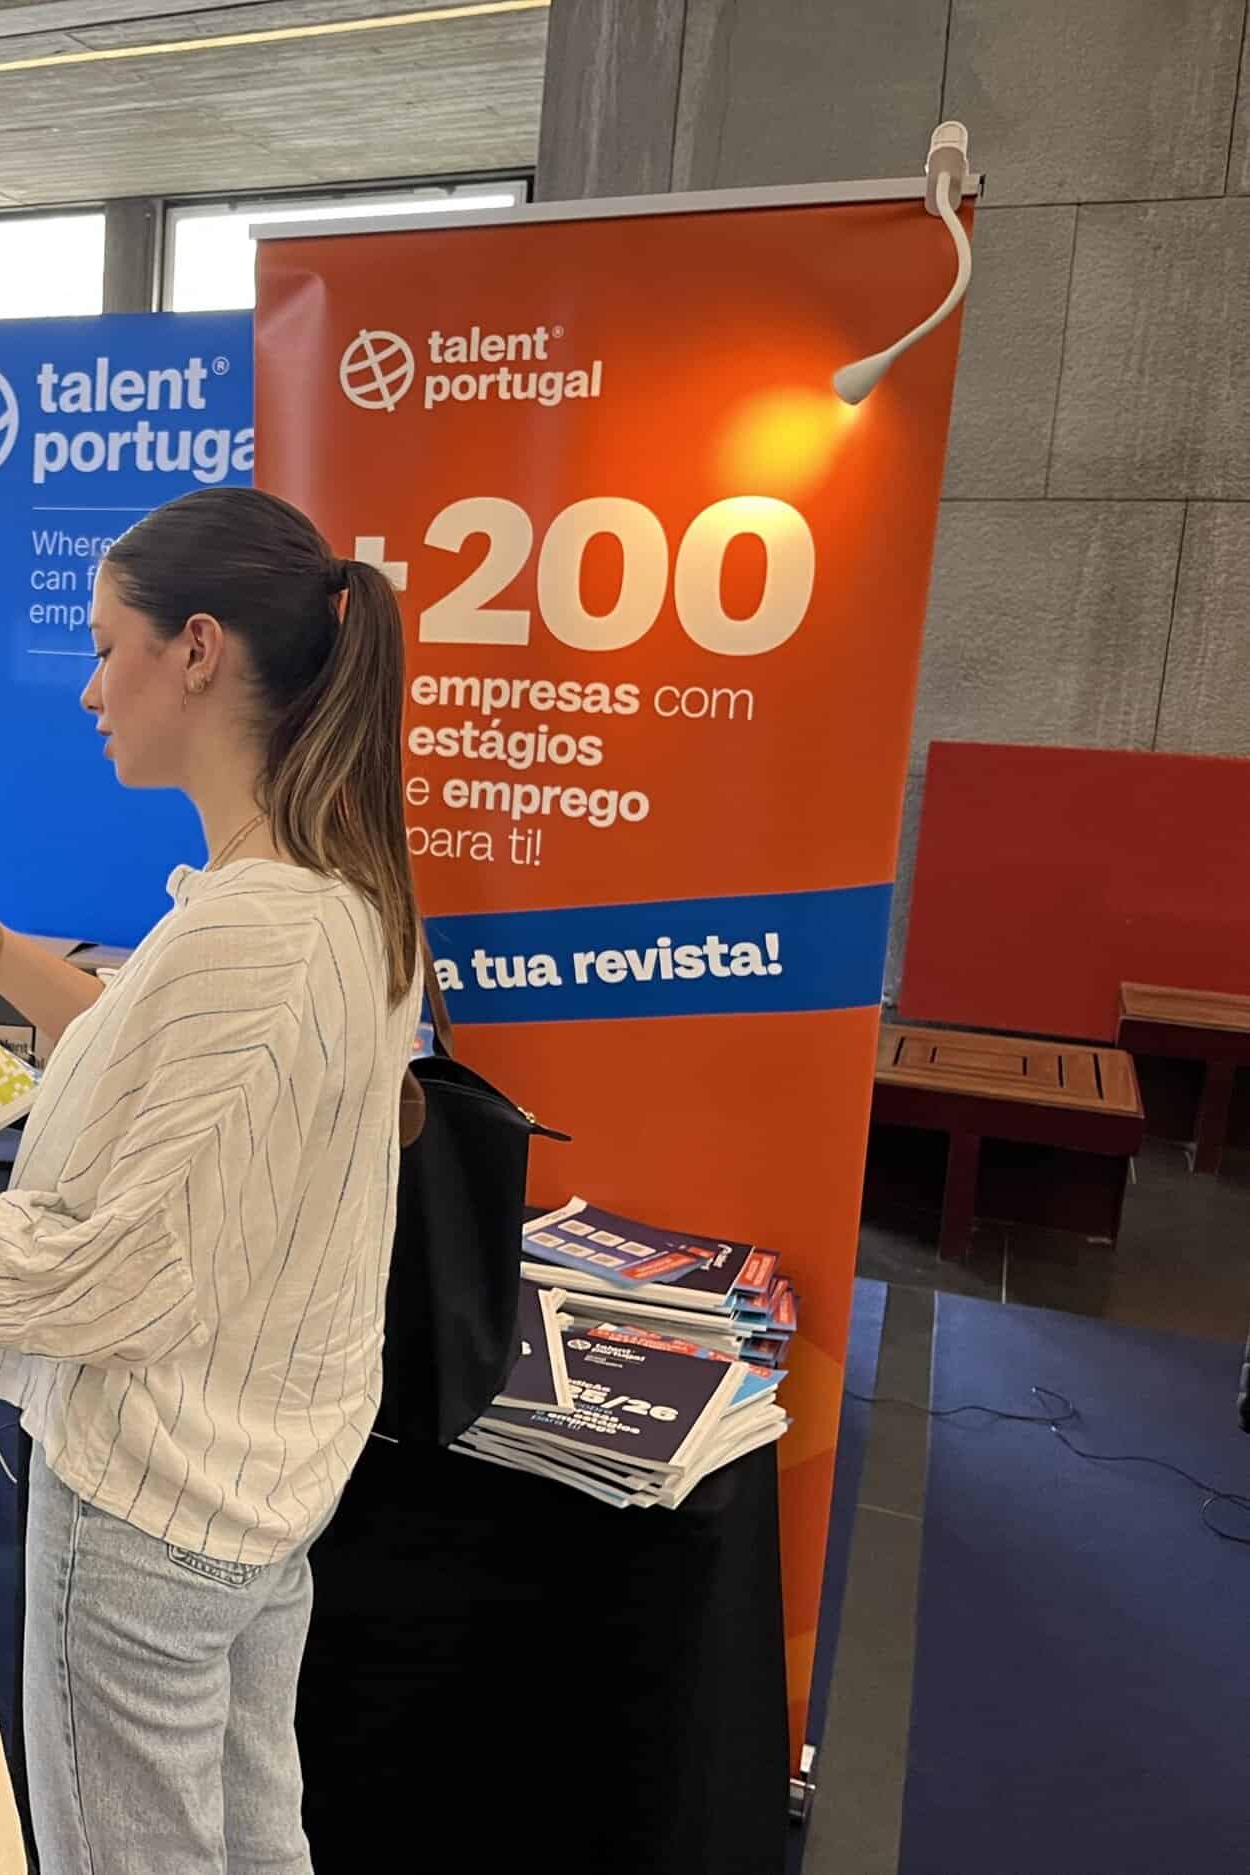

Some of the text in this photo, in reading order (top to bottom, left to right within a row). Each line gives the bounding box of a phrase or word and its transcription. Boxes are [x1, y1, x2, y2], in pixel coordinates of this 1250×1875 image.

[424, 360, 602, 410] portugal
[33, 421, 255, 485] portuga
[30, 570, 77, 592] can
[410, 674, 756, 721] empresas com
[407, 718, 604, 770] estágios
[405, 776, 650, 828] e emprego
[405, 825, 543, 867] para ti!
[471, 949, 563, 991] tua
[572, 932, 783, 985] revista!
